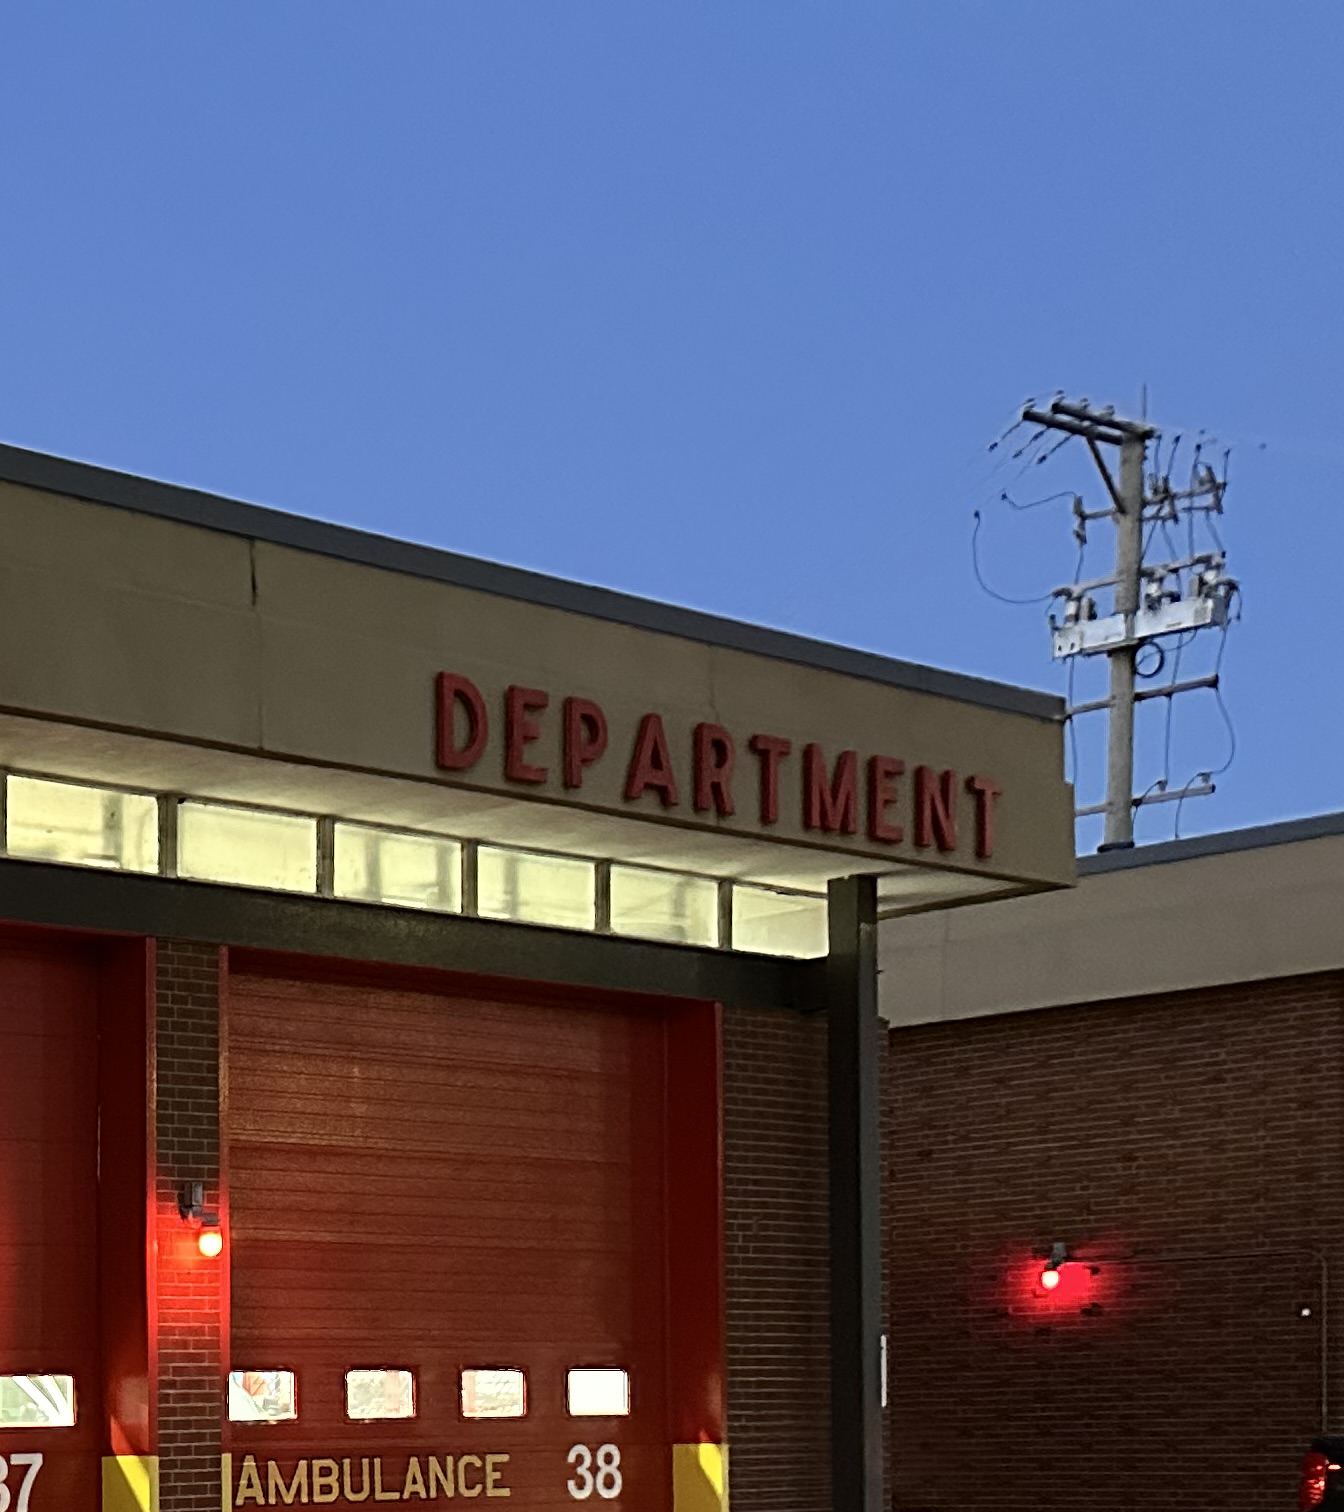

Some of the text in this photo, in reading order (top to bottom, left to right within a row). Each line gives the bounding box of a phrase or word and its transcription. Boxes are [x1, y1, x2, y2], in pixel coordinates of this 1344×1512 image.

[435, 670, 1003, 860] DEPARTMENT
[235, 1443, 623, 1506] AMBULANCE 38
